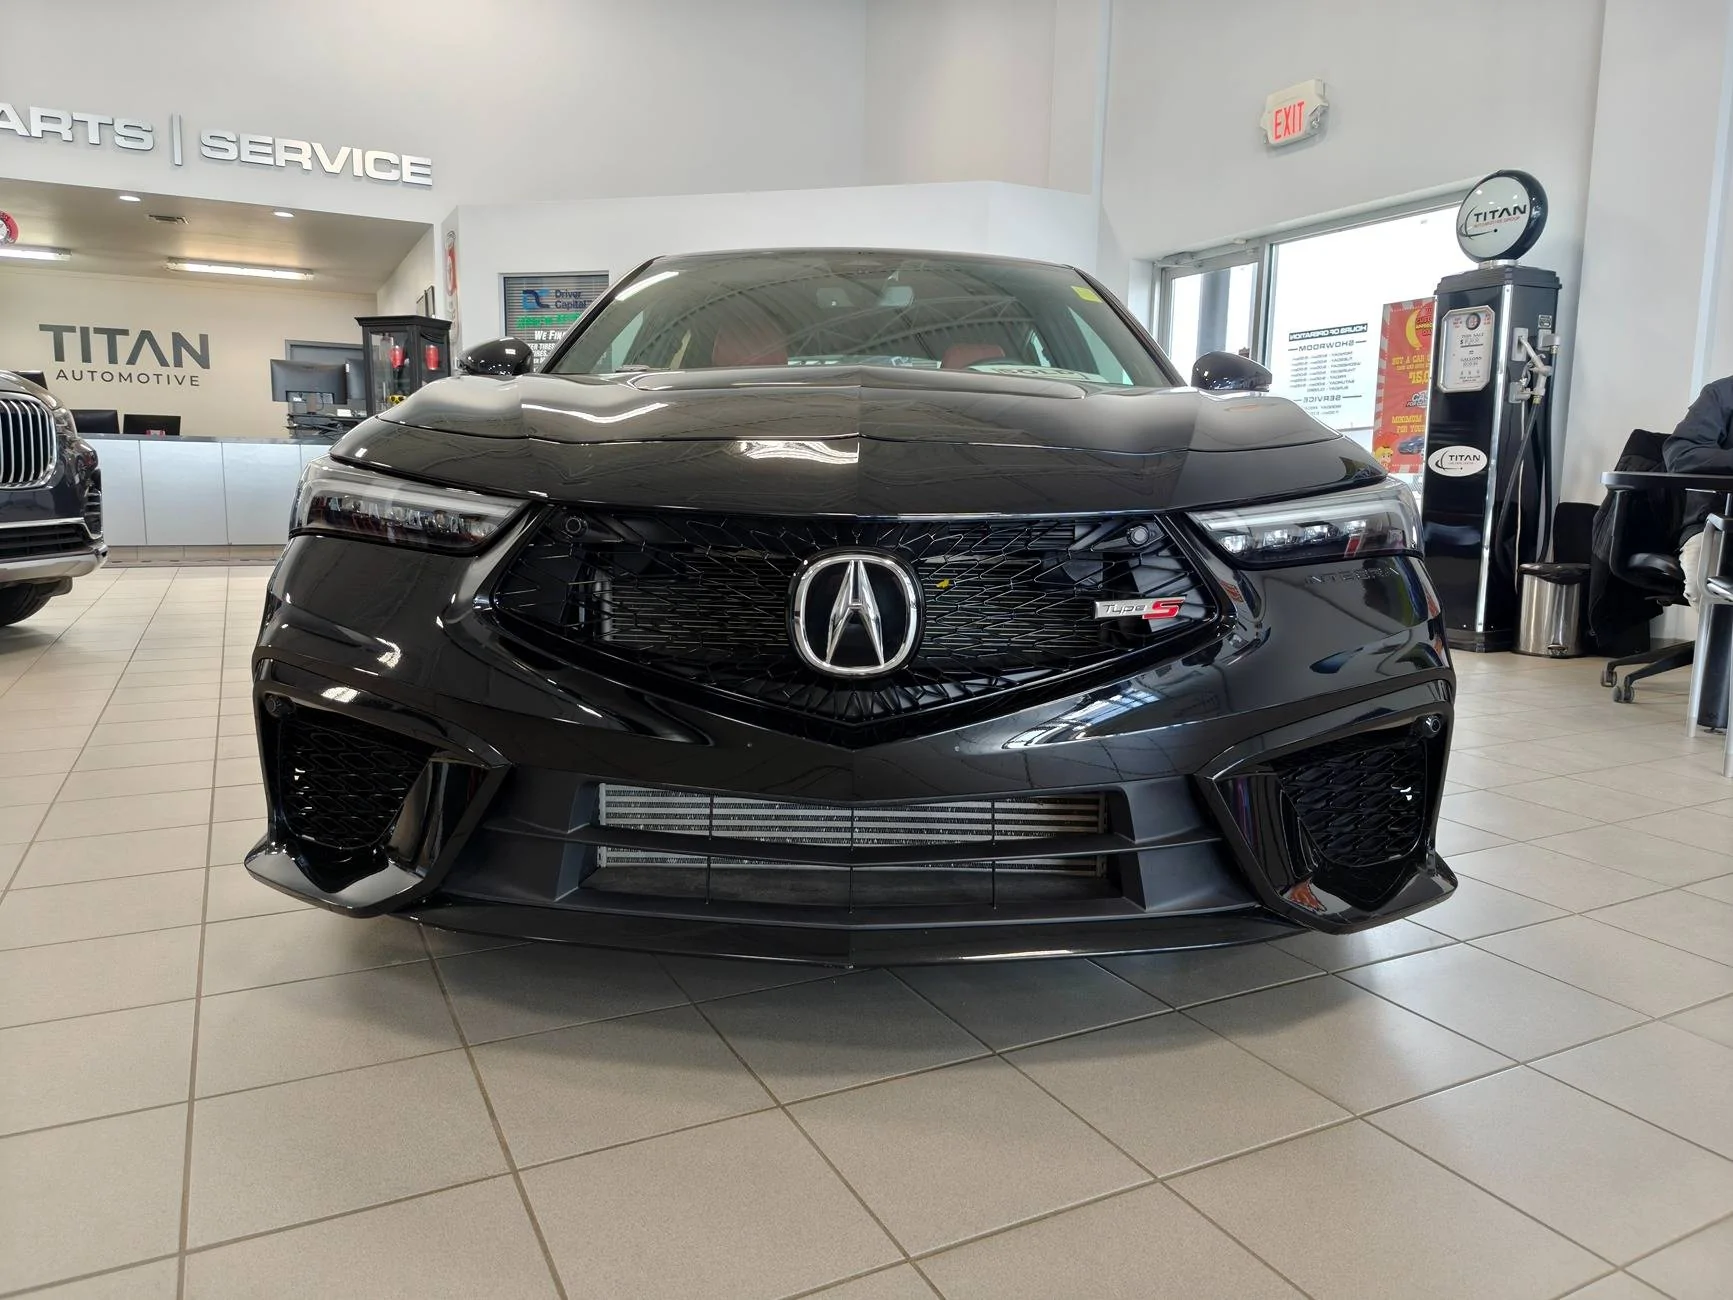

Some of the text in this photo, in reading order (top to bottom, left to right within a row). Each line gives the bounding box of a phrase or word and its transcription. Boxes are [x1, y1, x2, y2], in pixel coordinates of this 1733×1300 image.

[1273, 100, 1306, 141] EXIT
[200, 129, 433, 186] SERVICE
[1474, 204, 1527, 223] TITAN
[555, 288, 582, 299] Driver
[555, 300, 587, 311] Capital
[39, 324, 211, 369] TITAN
[55, 368, 200, 387] AUTOMOTIVE
[1448, 454, 1481, 462] TITAN
[1102, 599, 1186, 620] Type S
